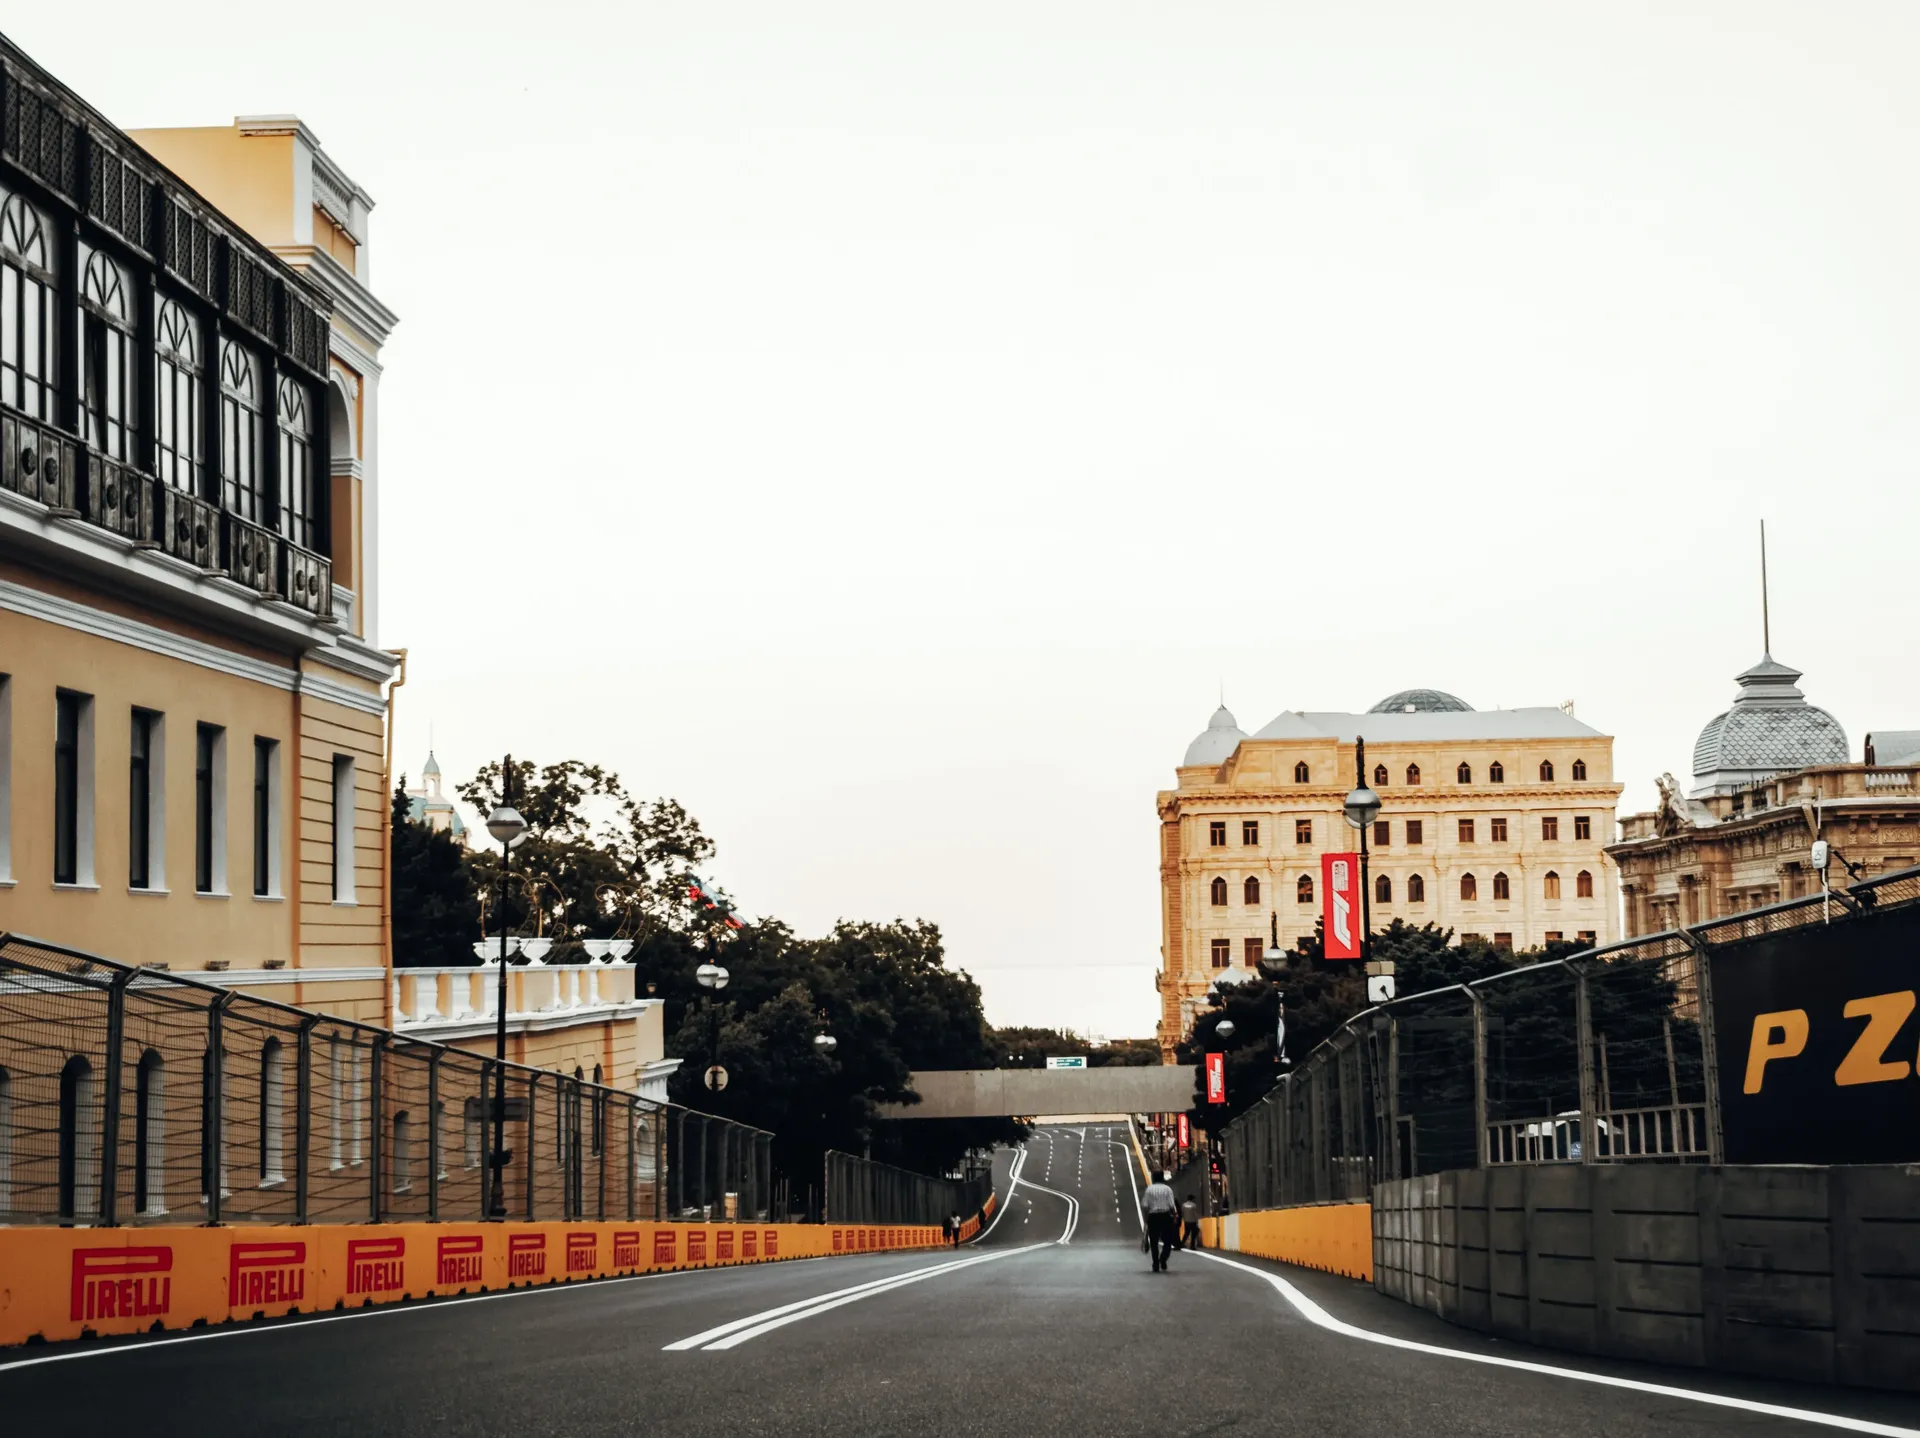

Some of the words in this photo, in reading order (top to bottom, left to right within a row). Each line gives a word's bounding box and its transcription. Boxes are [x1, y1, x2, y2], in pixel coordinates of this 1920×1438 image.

[1743, 1008, 1809, 1095] P
[1834, 990, 1920, 1086] Z
[228, 1242, 306, 1307] PIRELLI
[347, 1237, 405, 1295] PIRELLI
[437, 1235, 483, 1285] PIRELLI
[508, 1233, 546, 1278] PIRELLI
[566, 1232, 597, 1272] PIRELLI
[614, 1231, 640, 1267] PIRELLI
[71, 1246, 173, 1322] PIRELLI
